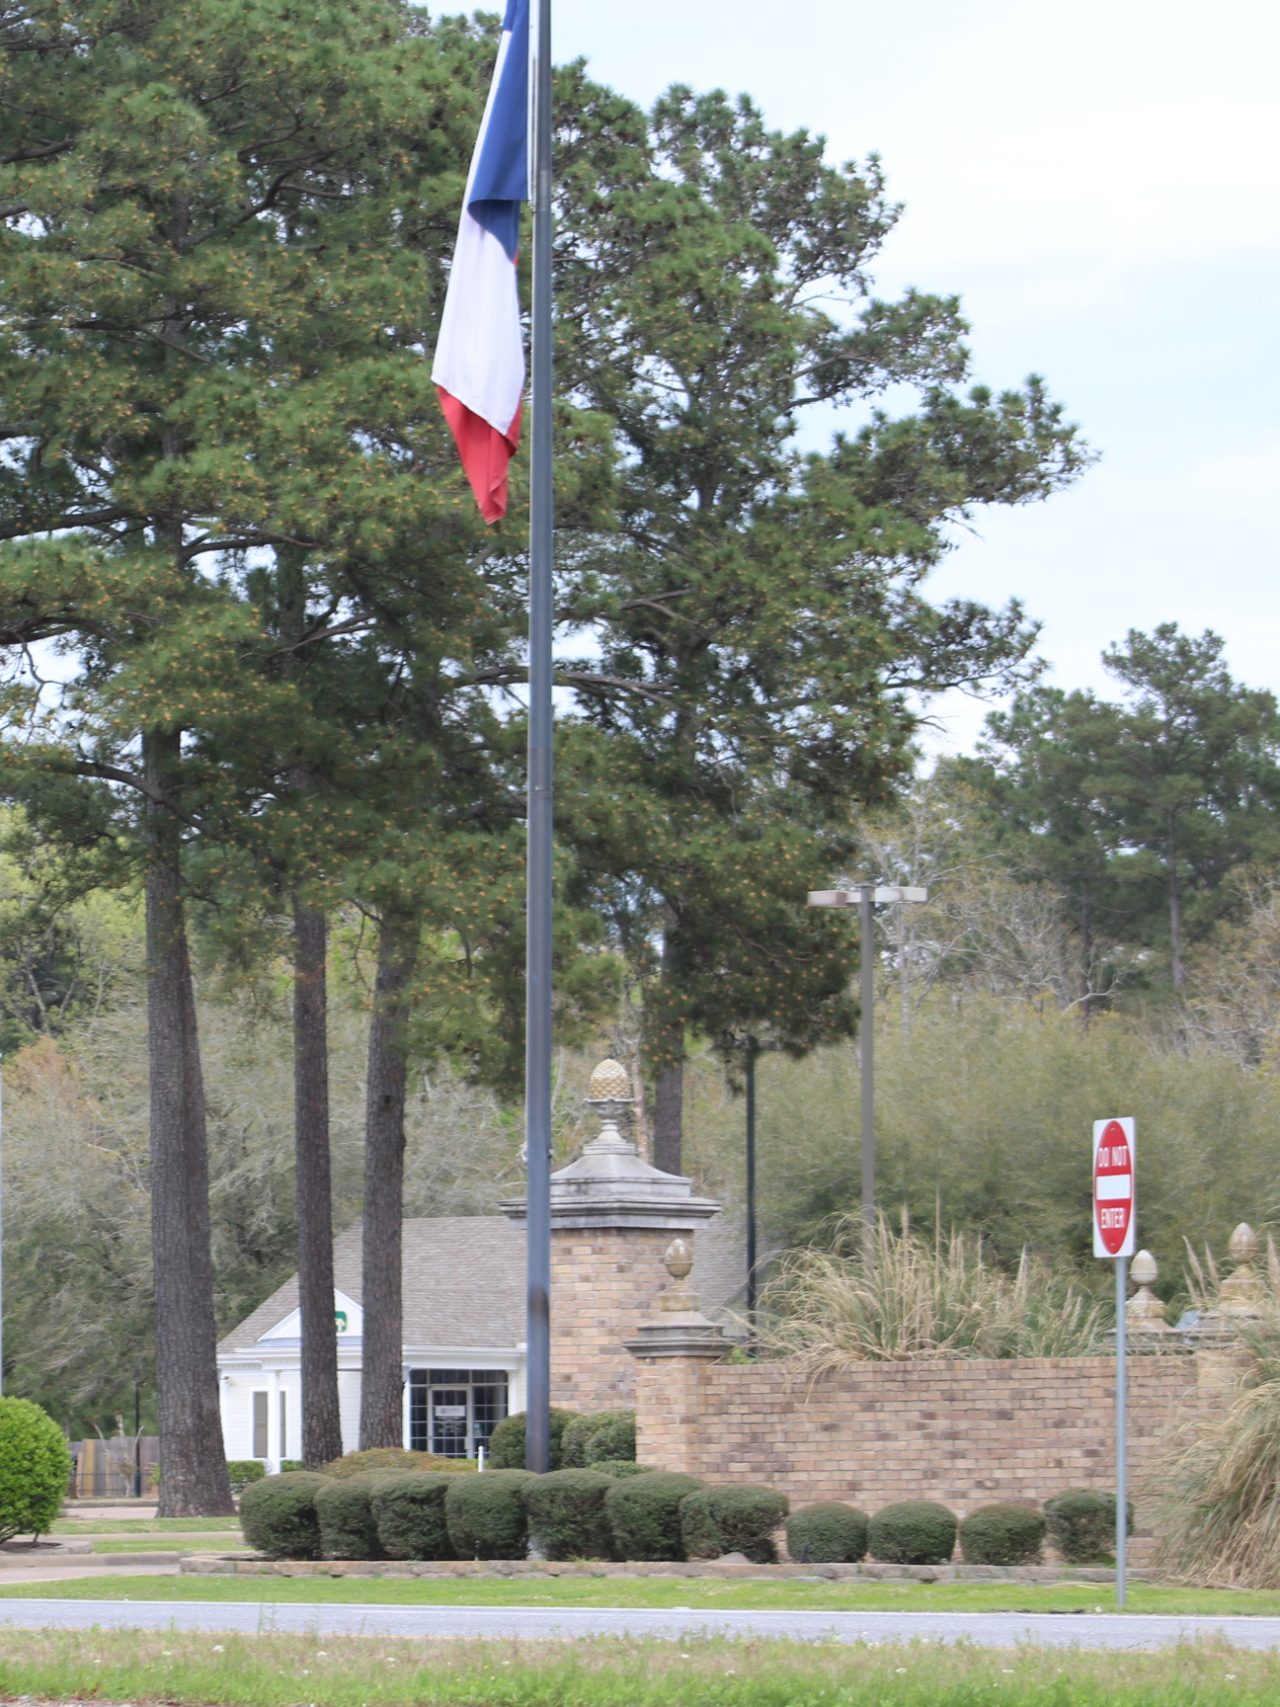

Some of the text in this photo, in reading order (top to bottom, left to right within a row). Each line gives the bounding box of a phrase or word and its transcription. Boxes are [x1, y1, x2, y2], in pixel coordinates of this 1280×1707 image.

[1098, 1145, 1128, 1168] DO NOT
[1101, 1207, 1125, 1229] ENTER
